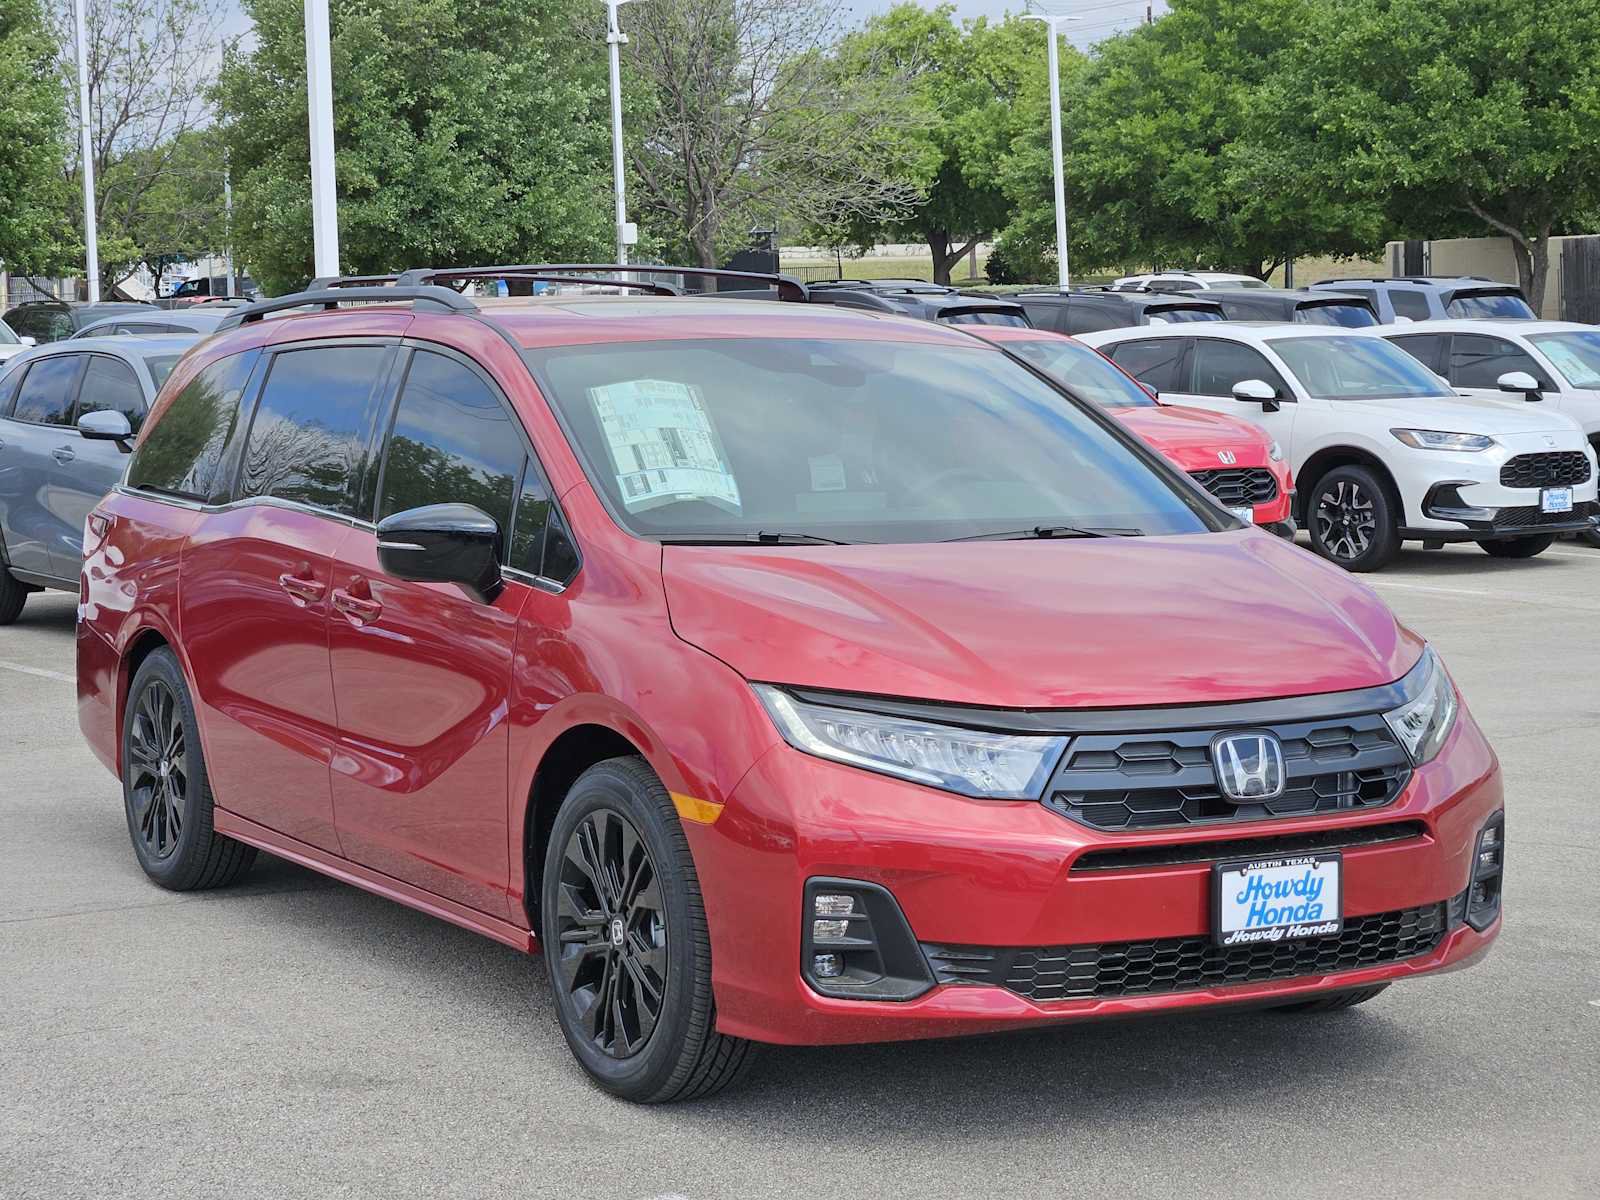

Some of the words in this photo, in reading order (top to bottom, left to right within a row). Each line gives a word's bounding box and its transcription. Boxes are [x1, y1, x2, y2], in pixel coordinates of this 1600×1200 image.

[1248, 860, 1282, 870] AUSTIN
[1285, 857, 1316, 866] TEXAS
[1236, 870, 1324, 904] Howdy
[1245, 901, 1323, 928] Honda
[1224, 927, 1284, 944] Howdy
[1286, 921, 1339, 938] Honda
